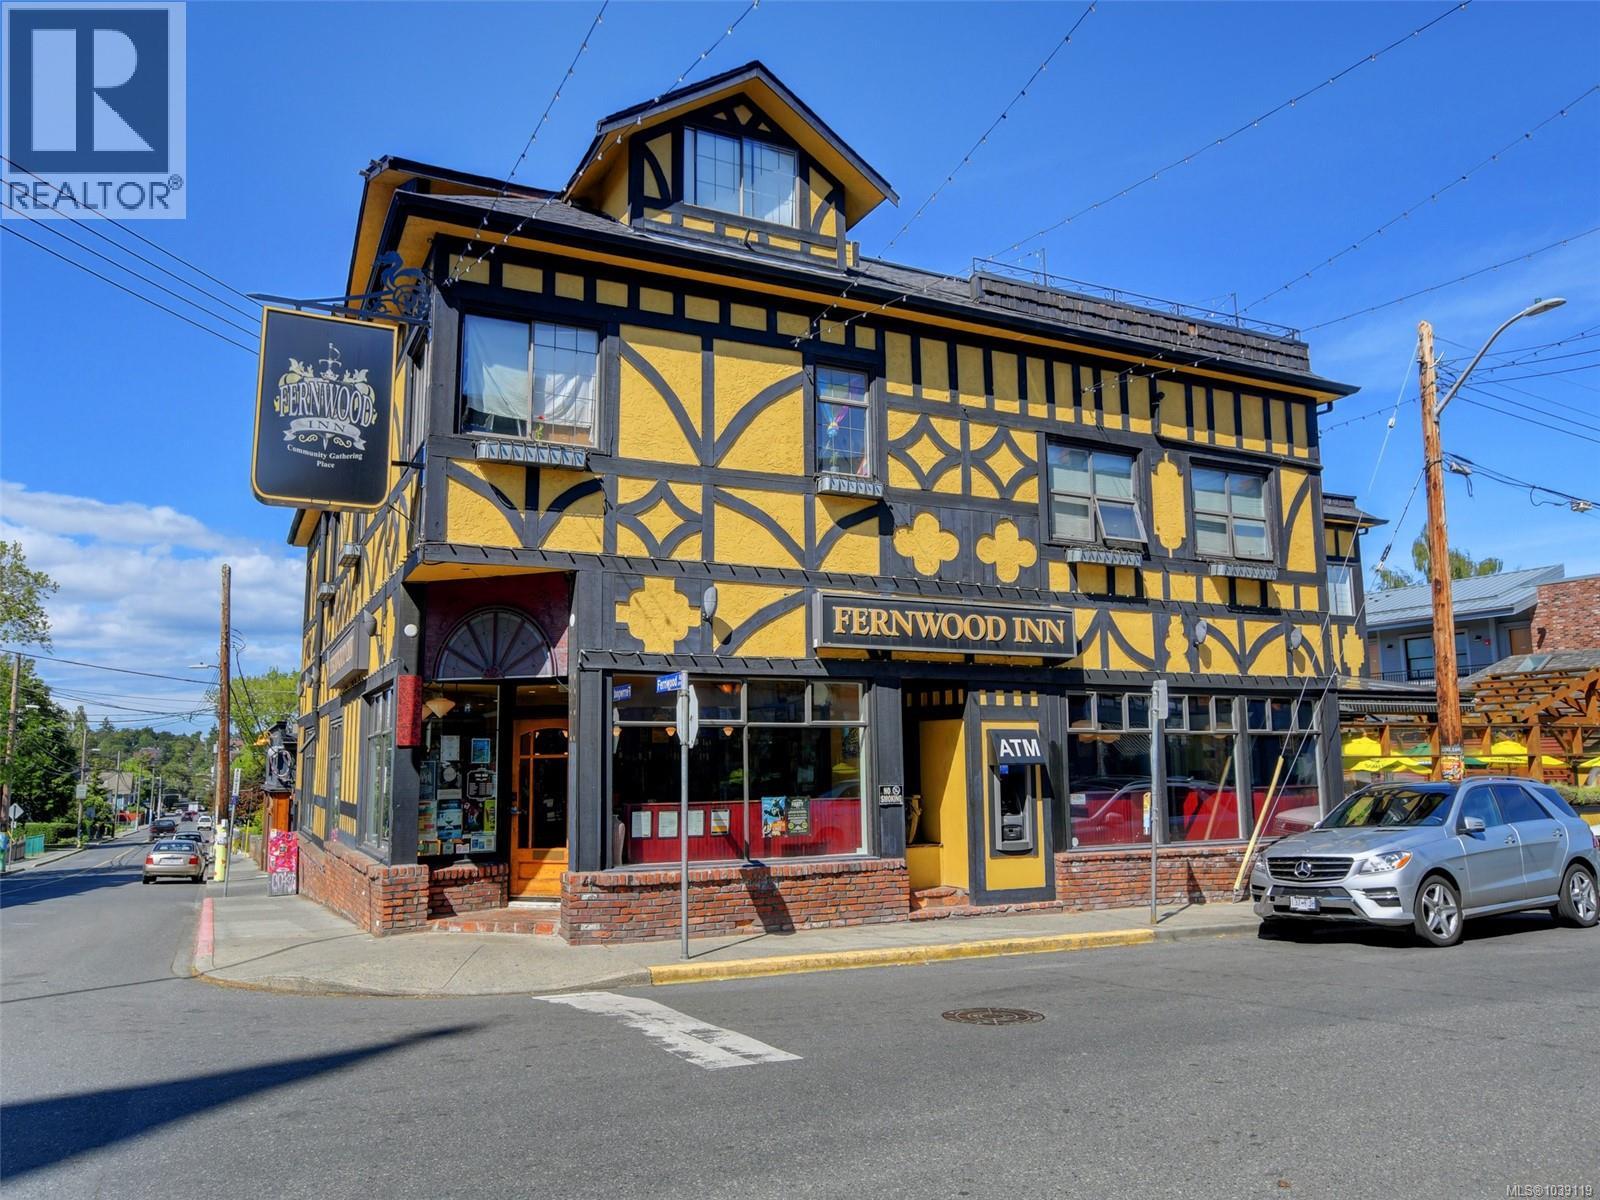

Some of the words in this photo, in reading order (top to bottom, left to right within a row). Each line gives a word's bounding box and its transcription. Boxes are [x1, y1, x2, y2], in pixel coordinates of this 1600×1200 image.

[279, 381, 374, 427] FERNWOOD
[308, 420, 345, 432] INN
[287, 444, 327, 460] Community
[329, 452, 363, 461] Gathering
[316, 460, 335, 469] Place
[832, 605, 1006, 642] FERNWOOD
[1012, 617, 1065, 644] INN
[1000, 738, 1041, 758] ATM
[883, 787, 891, 795] NO
